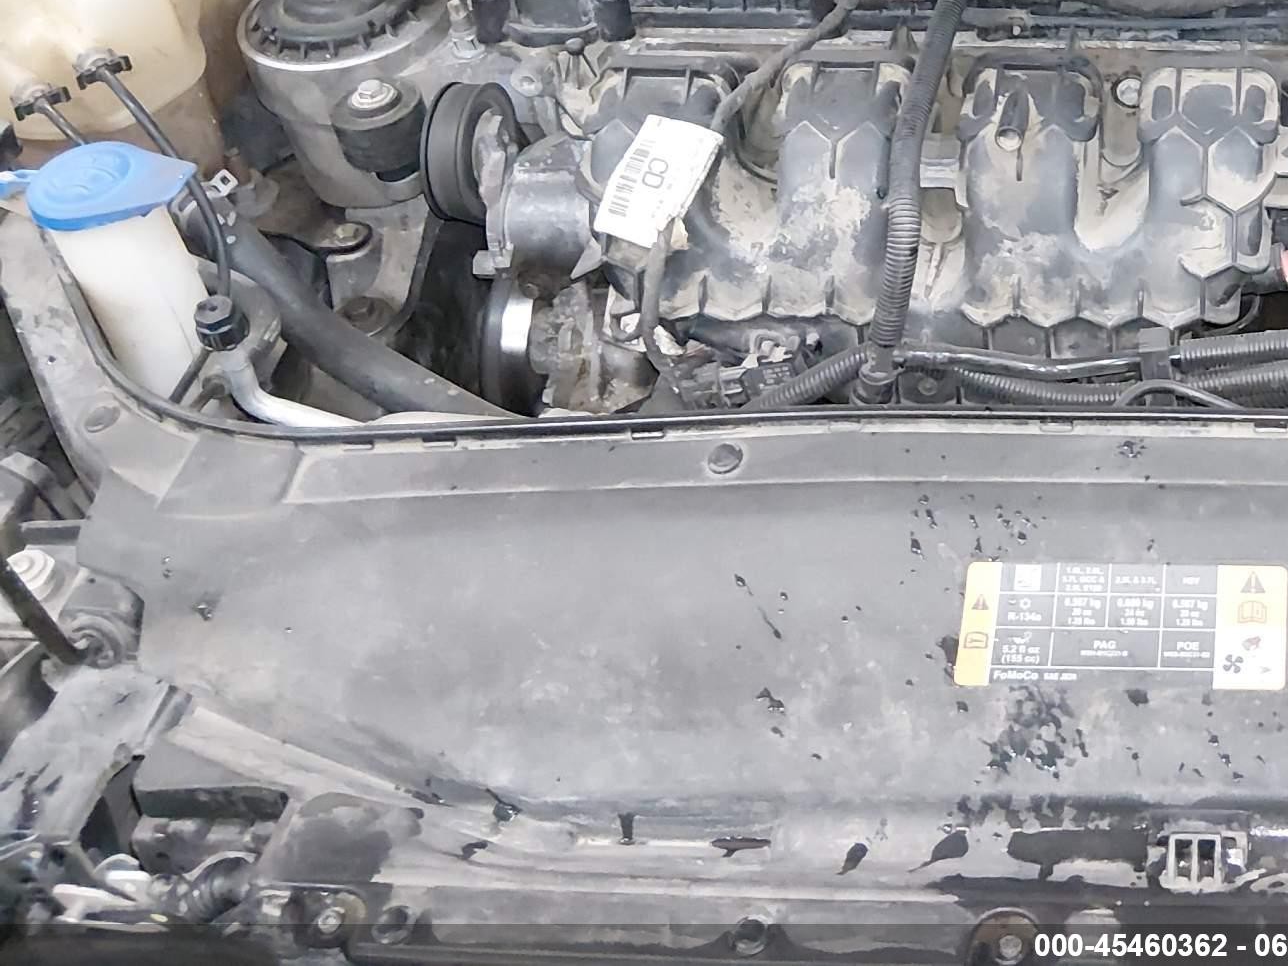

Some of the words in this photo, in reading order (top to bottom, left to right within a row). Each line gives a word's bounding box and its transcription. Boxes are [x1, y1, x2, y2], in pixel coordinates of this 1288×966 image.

[1093, 639, 1117, 650] PAG
[1176, 641, 1200, 651] POE
[993, 670, 1039, 681] FoMoCo
